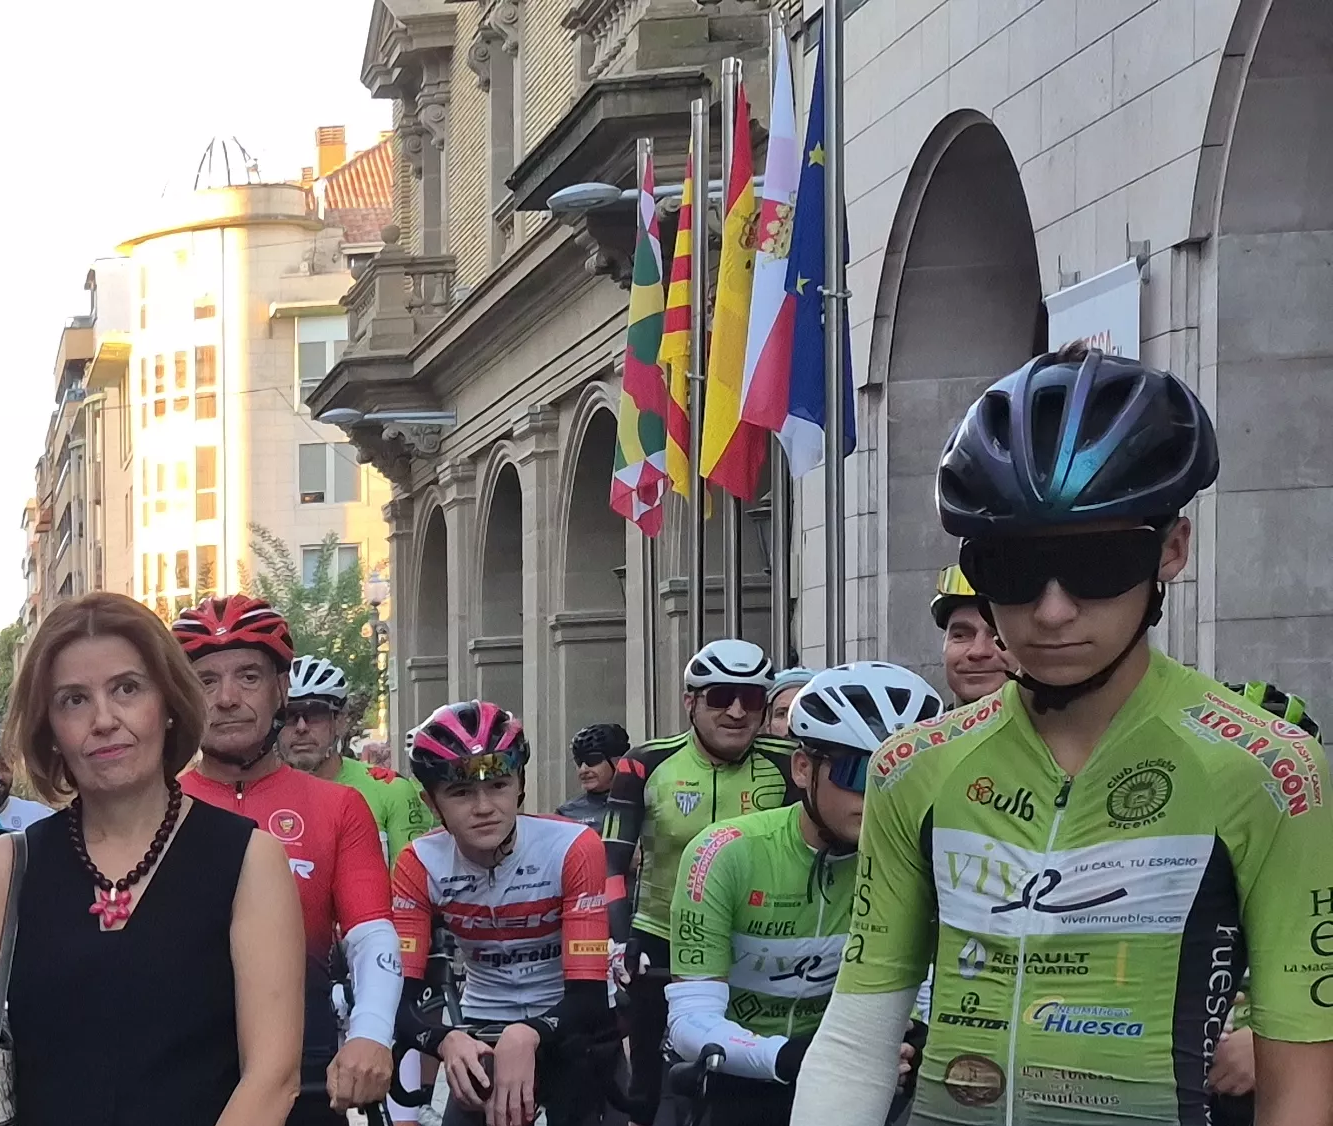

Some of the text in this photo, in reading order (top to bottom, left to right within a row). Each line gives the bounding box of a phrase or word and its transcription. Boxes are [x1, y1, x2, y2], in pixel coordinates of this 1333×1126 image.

[1107, 766, 1133, 789] club
[1109, 811, 1167, 830] oscense
[1130, 859, 1145, 868] TU
[1148, 857, 1198, 868] ESPACIO
[443, 907, 562, 930] TREK
[1060, 914, 1183, 925] viveinmuebles.com
[991, 952, 1090, 965] RENAULT
[1025, 965, 1089, 976] CUATRO
[1044, 1014, 1143, 1038] Huesca
